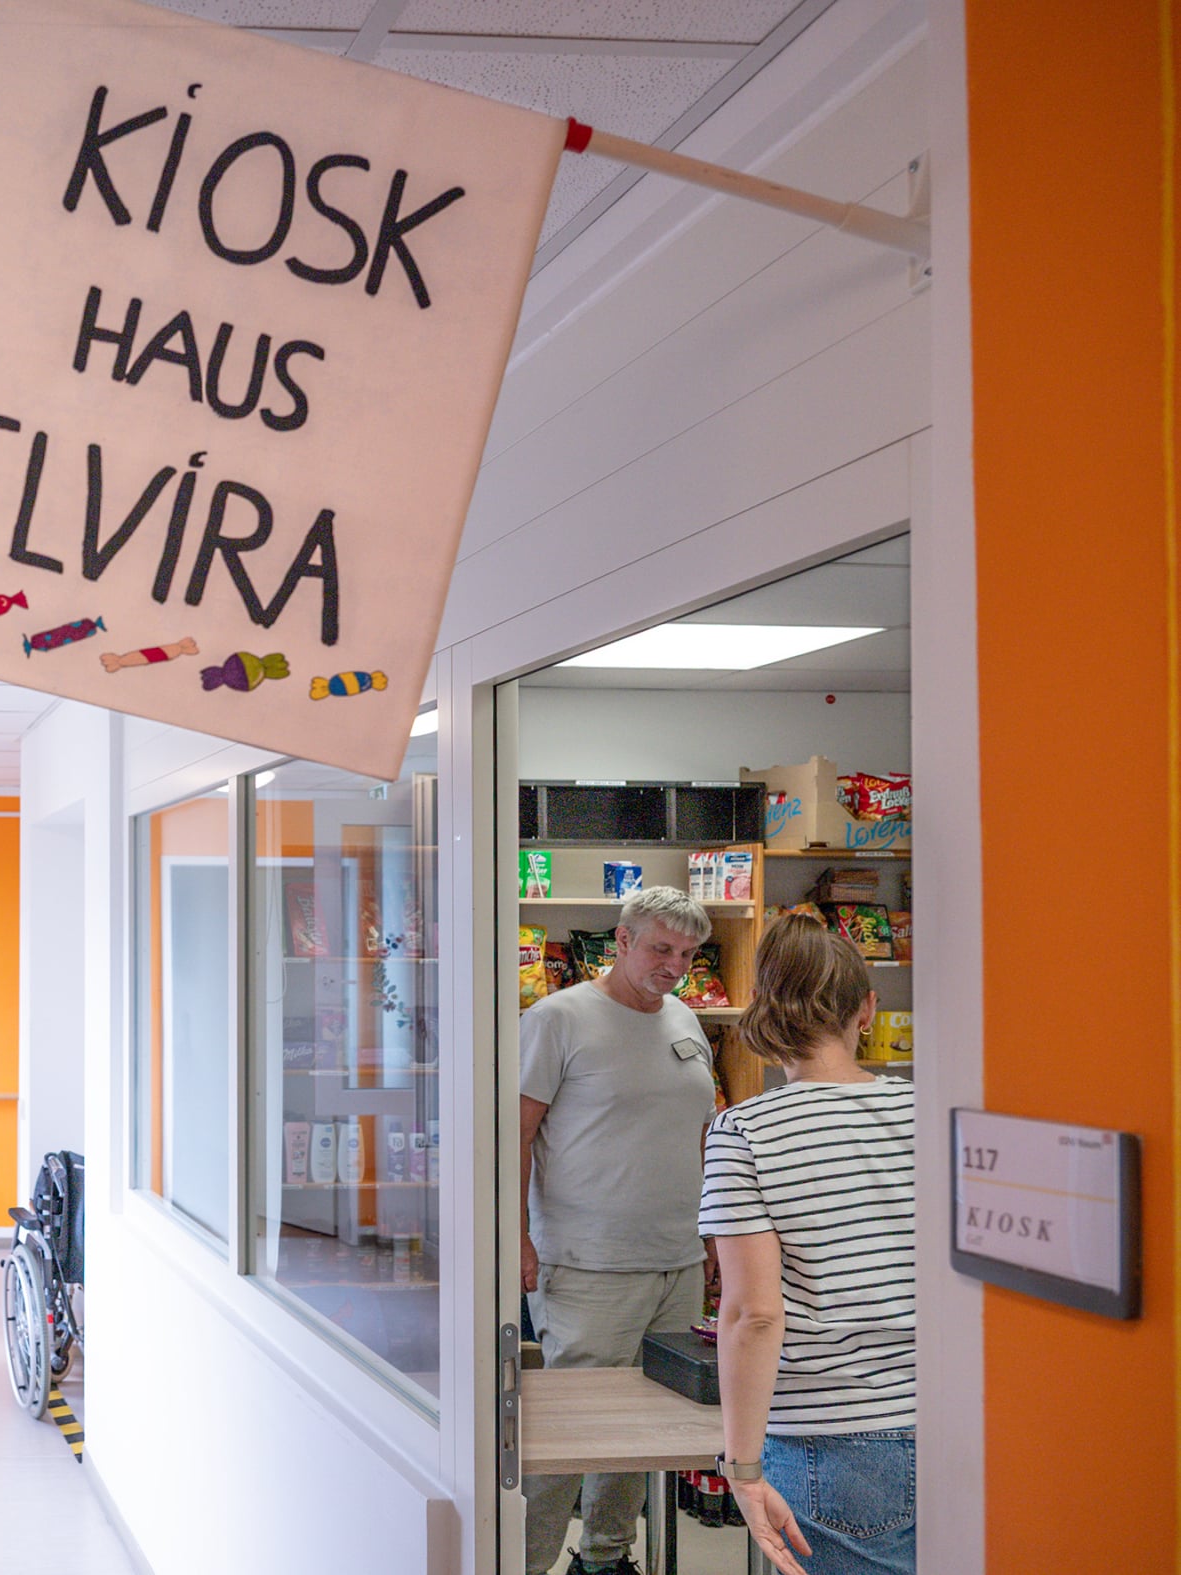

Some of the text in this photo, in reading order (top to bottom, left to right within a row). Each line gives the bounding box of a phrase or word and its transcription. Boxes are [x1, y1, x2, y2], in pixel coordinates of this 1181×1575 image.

[72, 286, 325, 432] HAUS
[764, 797, 802, 824] renz
[962, 1146, 999, 1172] 117
[966, 1206, 1054, 1243] KIOSK
